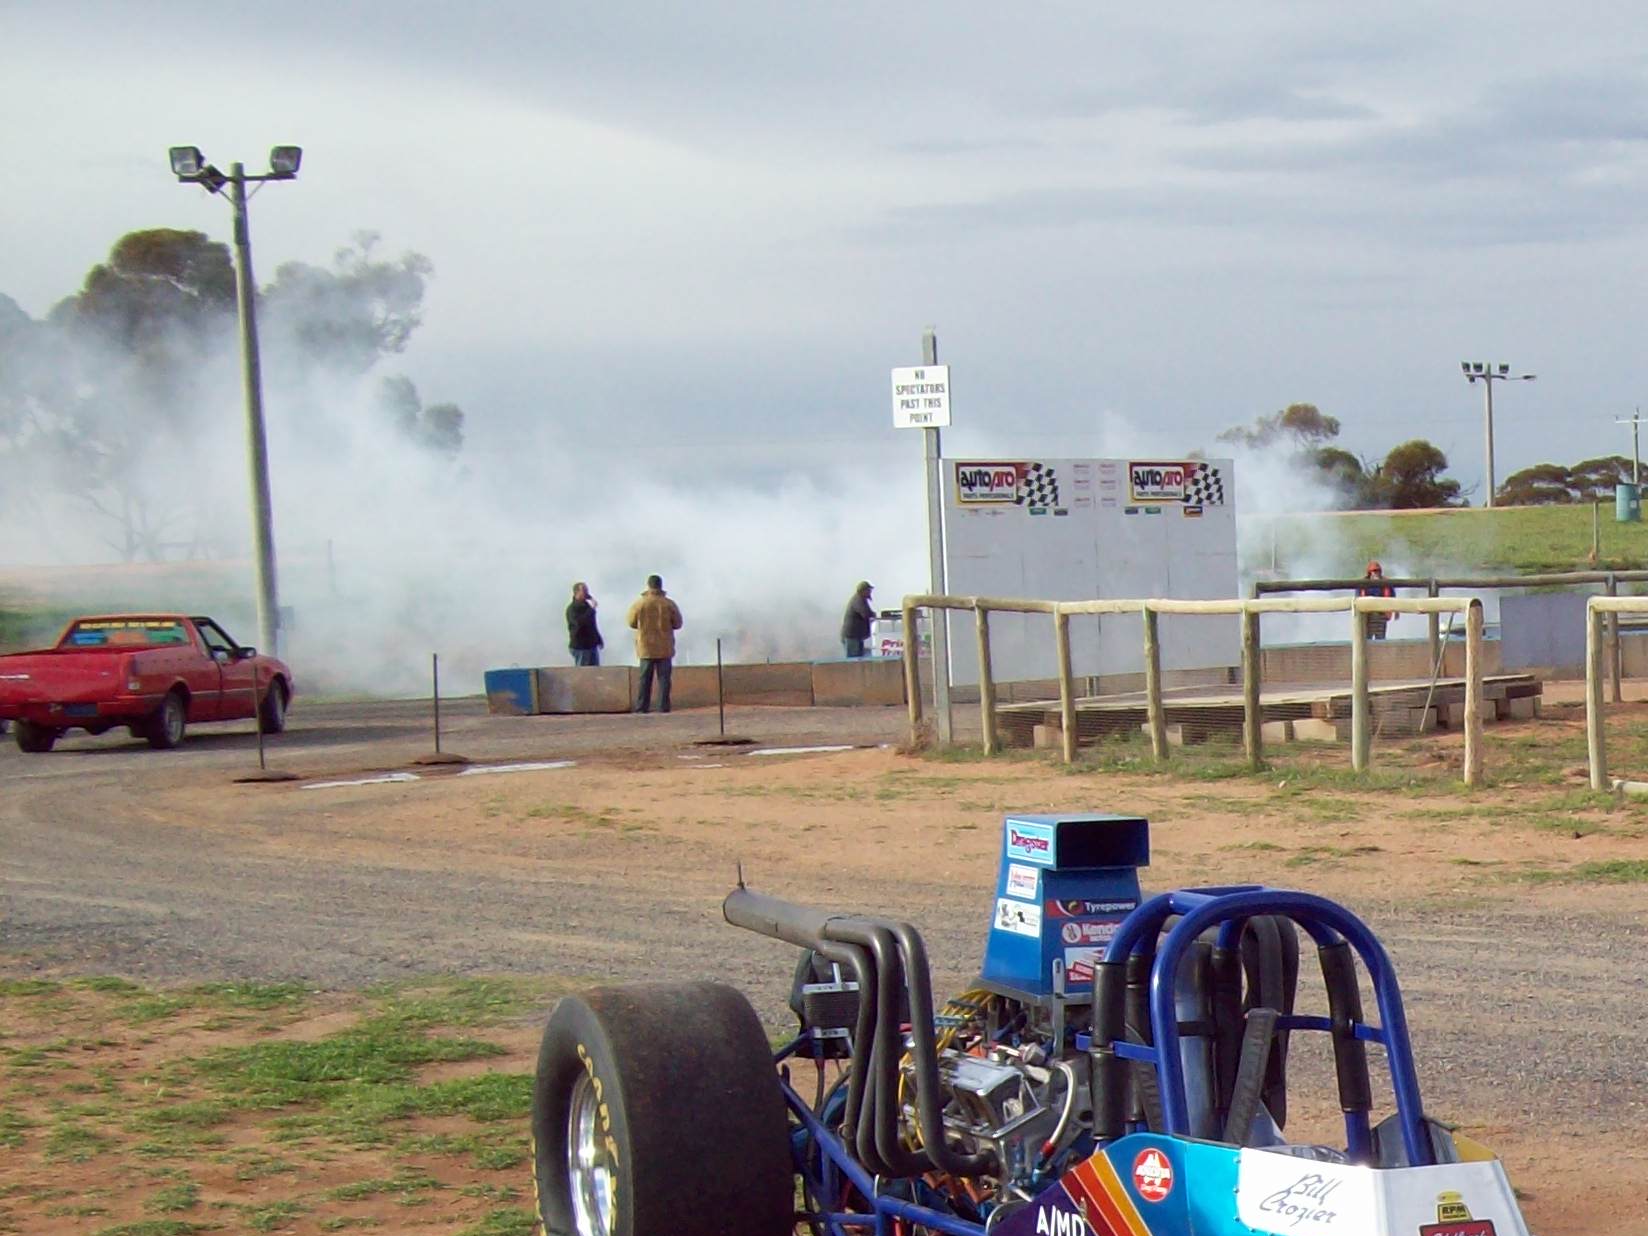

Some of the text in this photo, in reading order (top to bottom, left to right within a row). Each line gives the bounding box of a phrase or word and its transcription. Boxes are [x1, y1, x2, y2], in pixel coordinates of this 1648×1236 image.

[914, 370, 925, 380] NO
[895, 383, 945, 395] SPECTATORS
[901, 398, 941, 409] PAST THIS
[910, 413, 932, 423] POINT
[1085, 902, 1137, 912] Tyrepower
[1287, 1174, 1343, 1206] Bill
